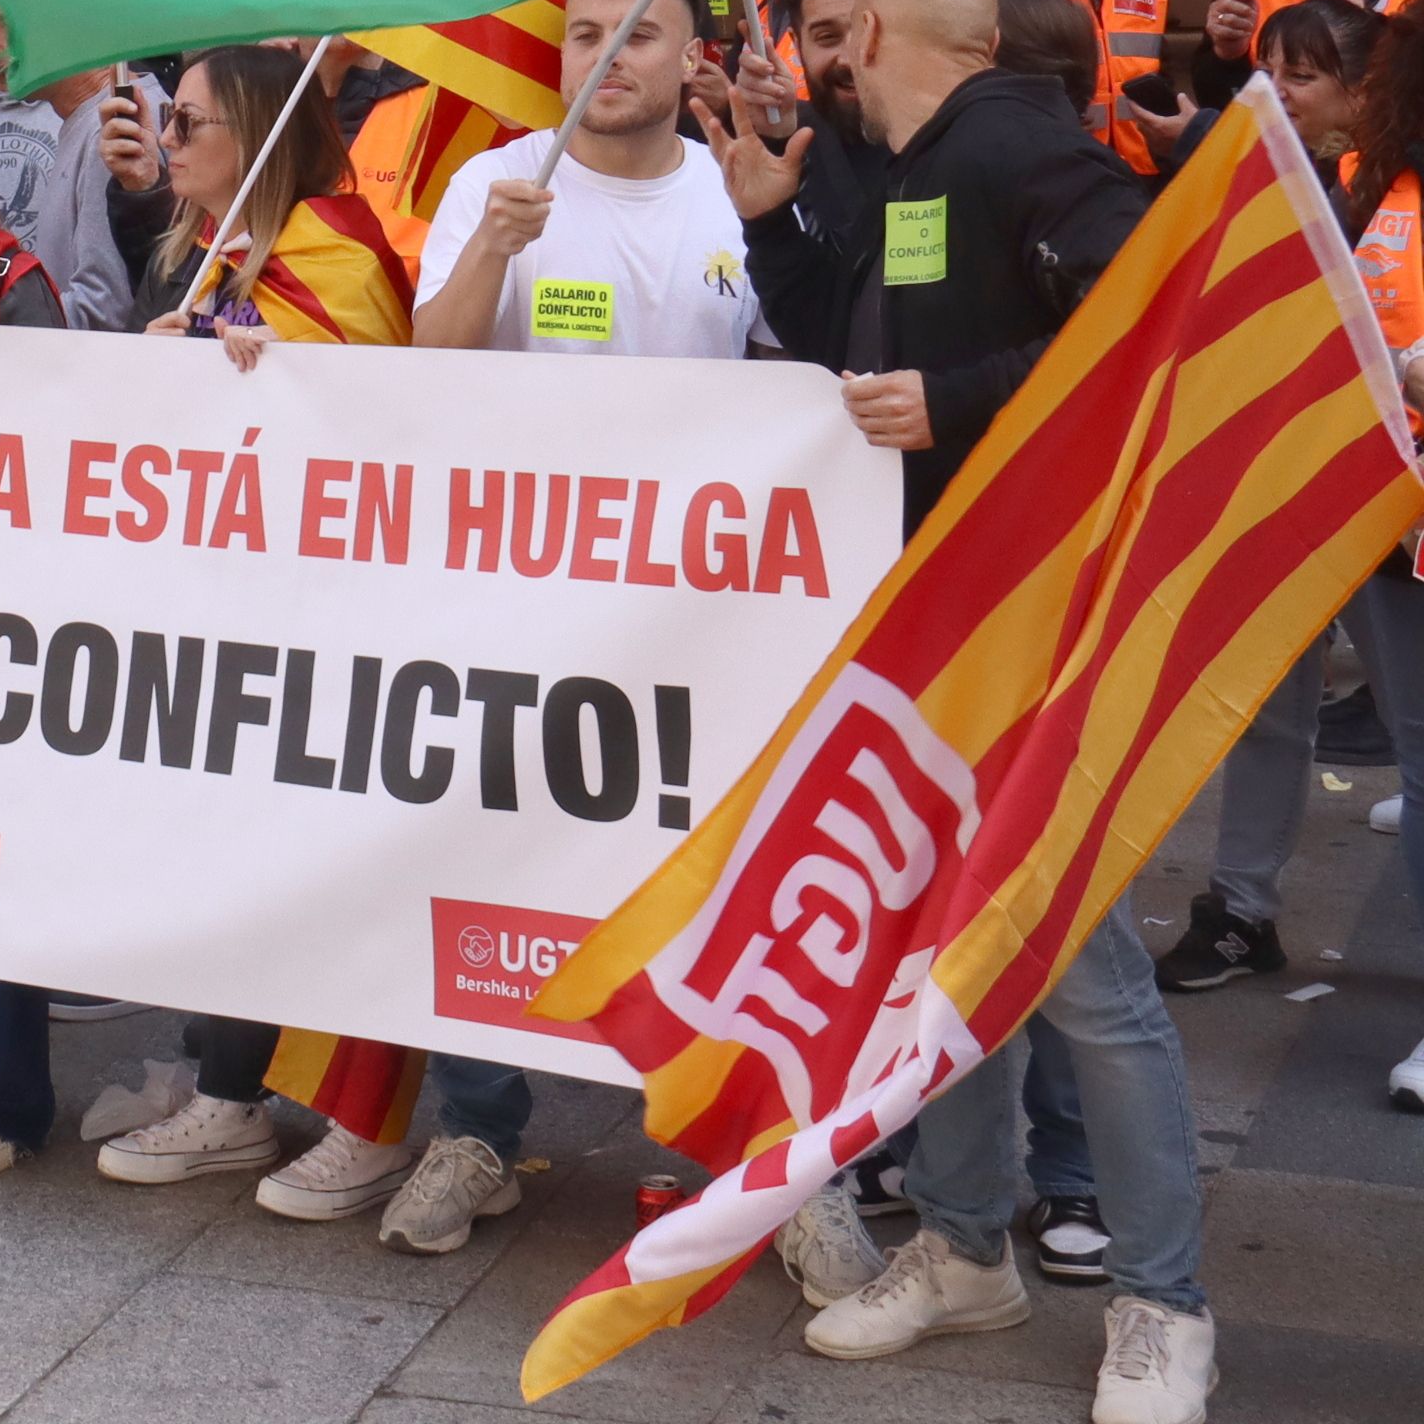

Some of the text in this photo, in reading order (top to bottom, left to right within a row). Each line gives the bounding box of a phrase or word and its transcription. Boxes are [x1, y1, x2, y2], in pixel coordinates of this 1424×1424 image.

[899, 206, 943, 221] SALARIO
[920, 228, 928, 238] O
[540, 287, 607, 302] ¡SALARIO O
[538, 303, 607, 319] CONFLICTO!
[62, 427, 268, 553] ESTÁ
[298, 458, 414, 566] EN
[445, 467, 831, 599] HUELGA
[456, 974, 520, 999] Bershka
